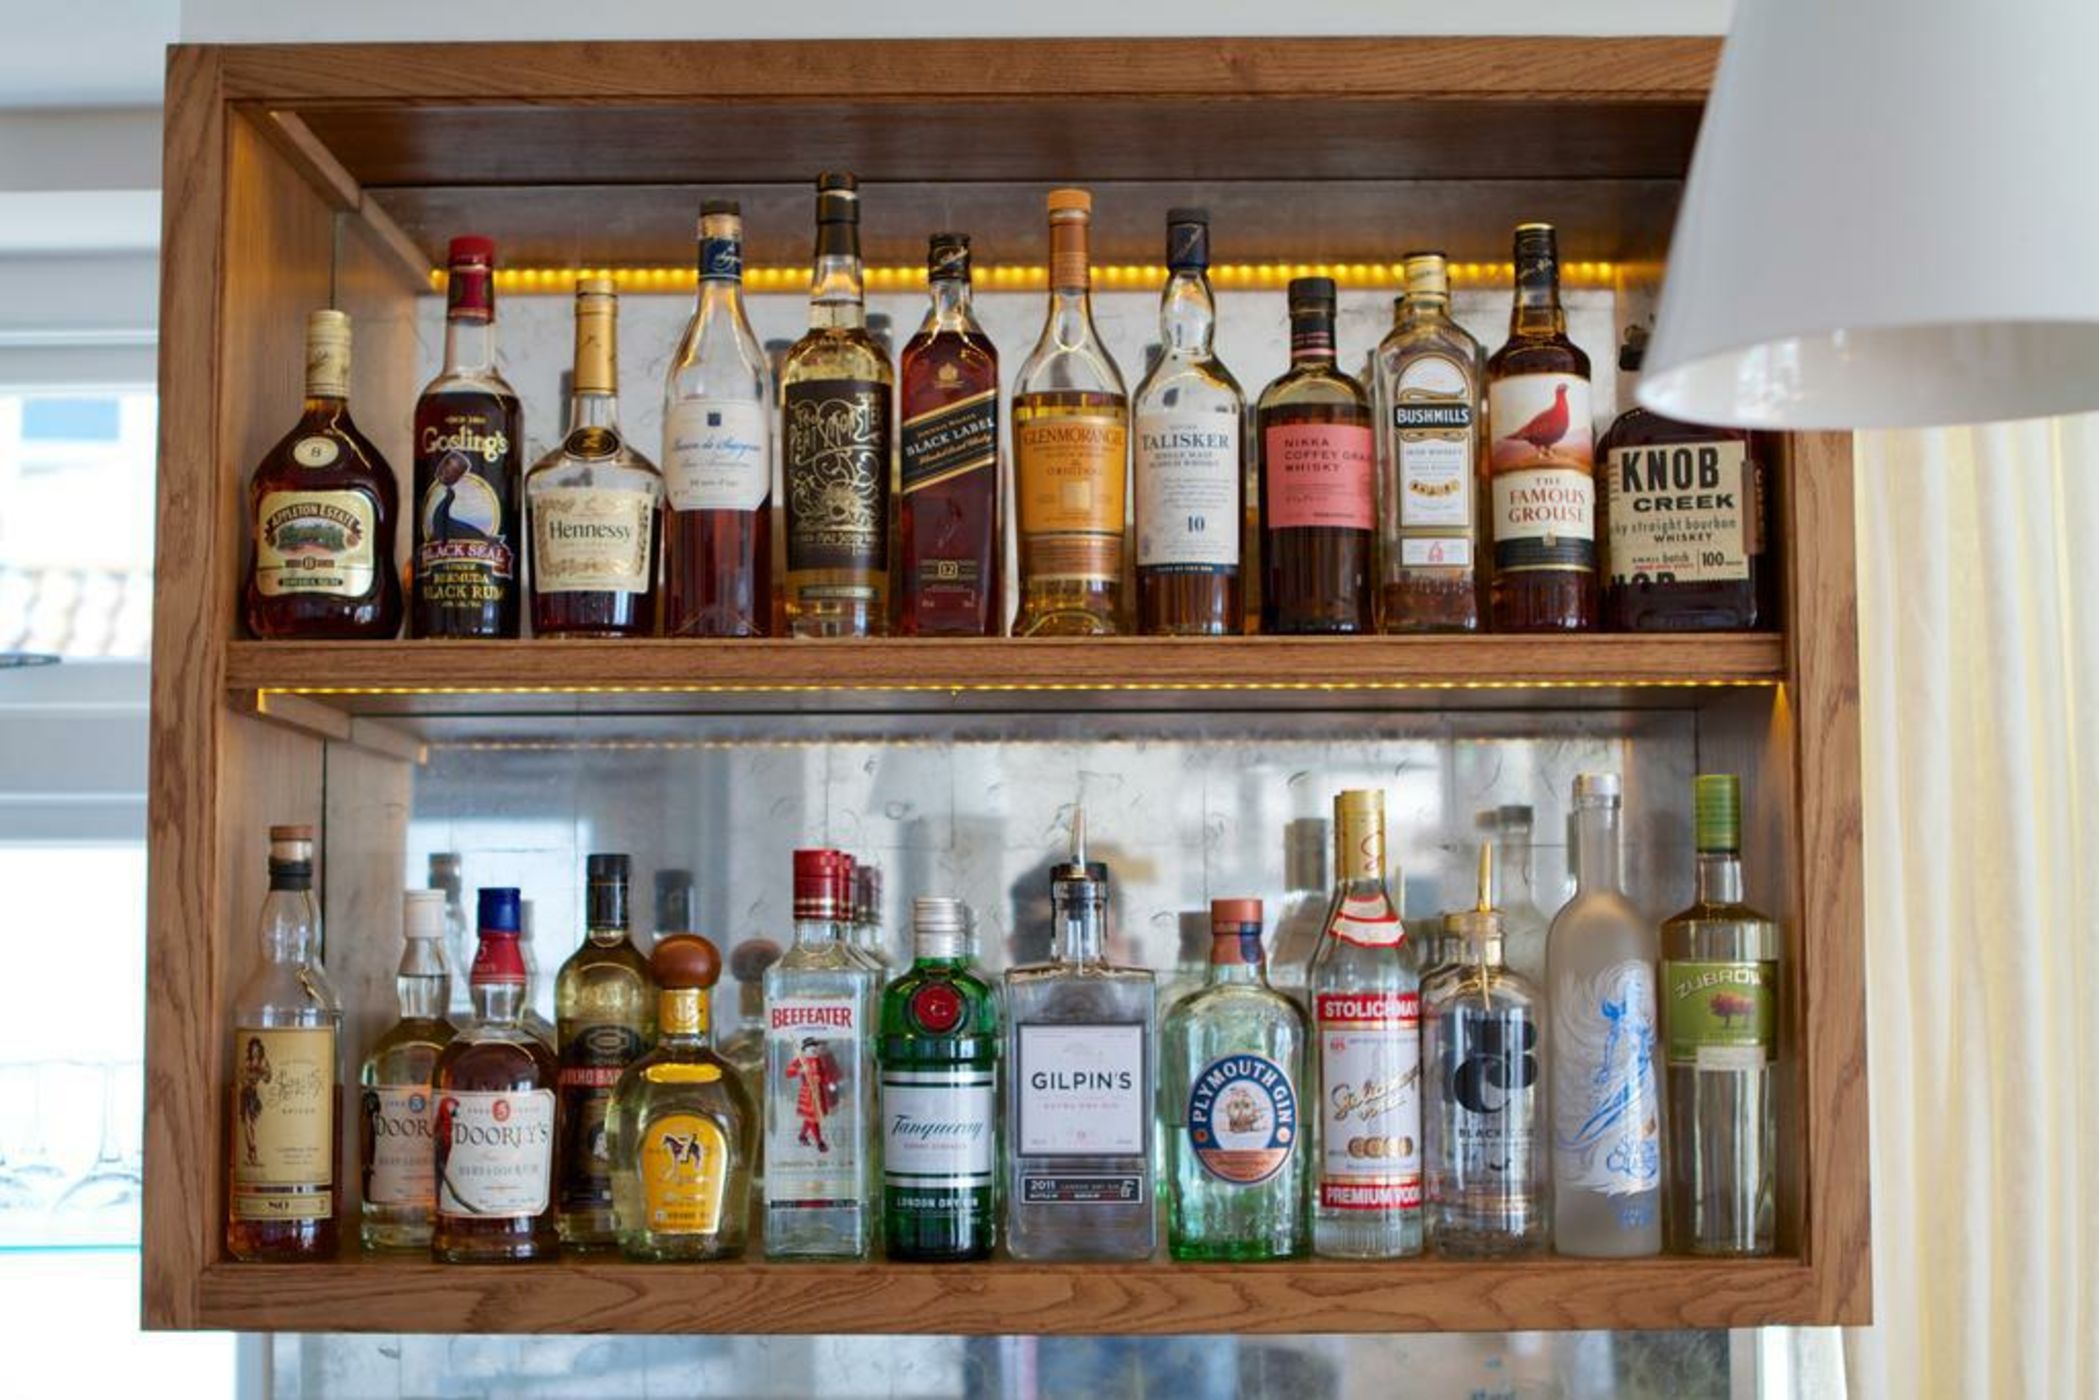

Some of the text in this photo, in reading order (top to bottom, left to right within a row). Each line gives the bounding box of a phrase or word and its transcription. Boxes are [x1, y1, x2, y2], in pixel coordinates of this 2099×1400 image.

[1396, 408, 1470, 424] BUSHMILLS
[423, 427, 509, 463] Gosling's
[906, 432, 950, 458] BLACK
[953, 417, 995, 440] LABEL
[1143, 433, 1229, 450] TALISKER
[1284, 439, 1330, 448] NIKKA
[1284, 450, 1338, 461] COFFEY
[1621, 446, 1720, 494] KNOB
[1509, 487, 1586, 504] FAMOUS
[1633, 494, 1736, 512] CREEK
[1508, 505, 1582, 523] GROUSE
[549, 519, 632, 544] Hennessy
[1187, 515, 1206, 534] 10
[1653, 533, 1713, 544] WHISKEY
[1702, 551, 1725, 567] 100
[772, 1006, 852, 1029] BEEFEATER
[1031, 1070, 1133, 1091] GILPIN'S
[1192, 1059, 1276, 1123] PLYMOUTH
[1272, 1085, 1293, 1123] GIN
[891, 1113, 985, 1141] Tanqueray
[1030, 1179, 1057, 1191] 2011
